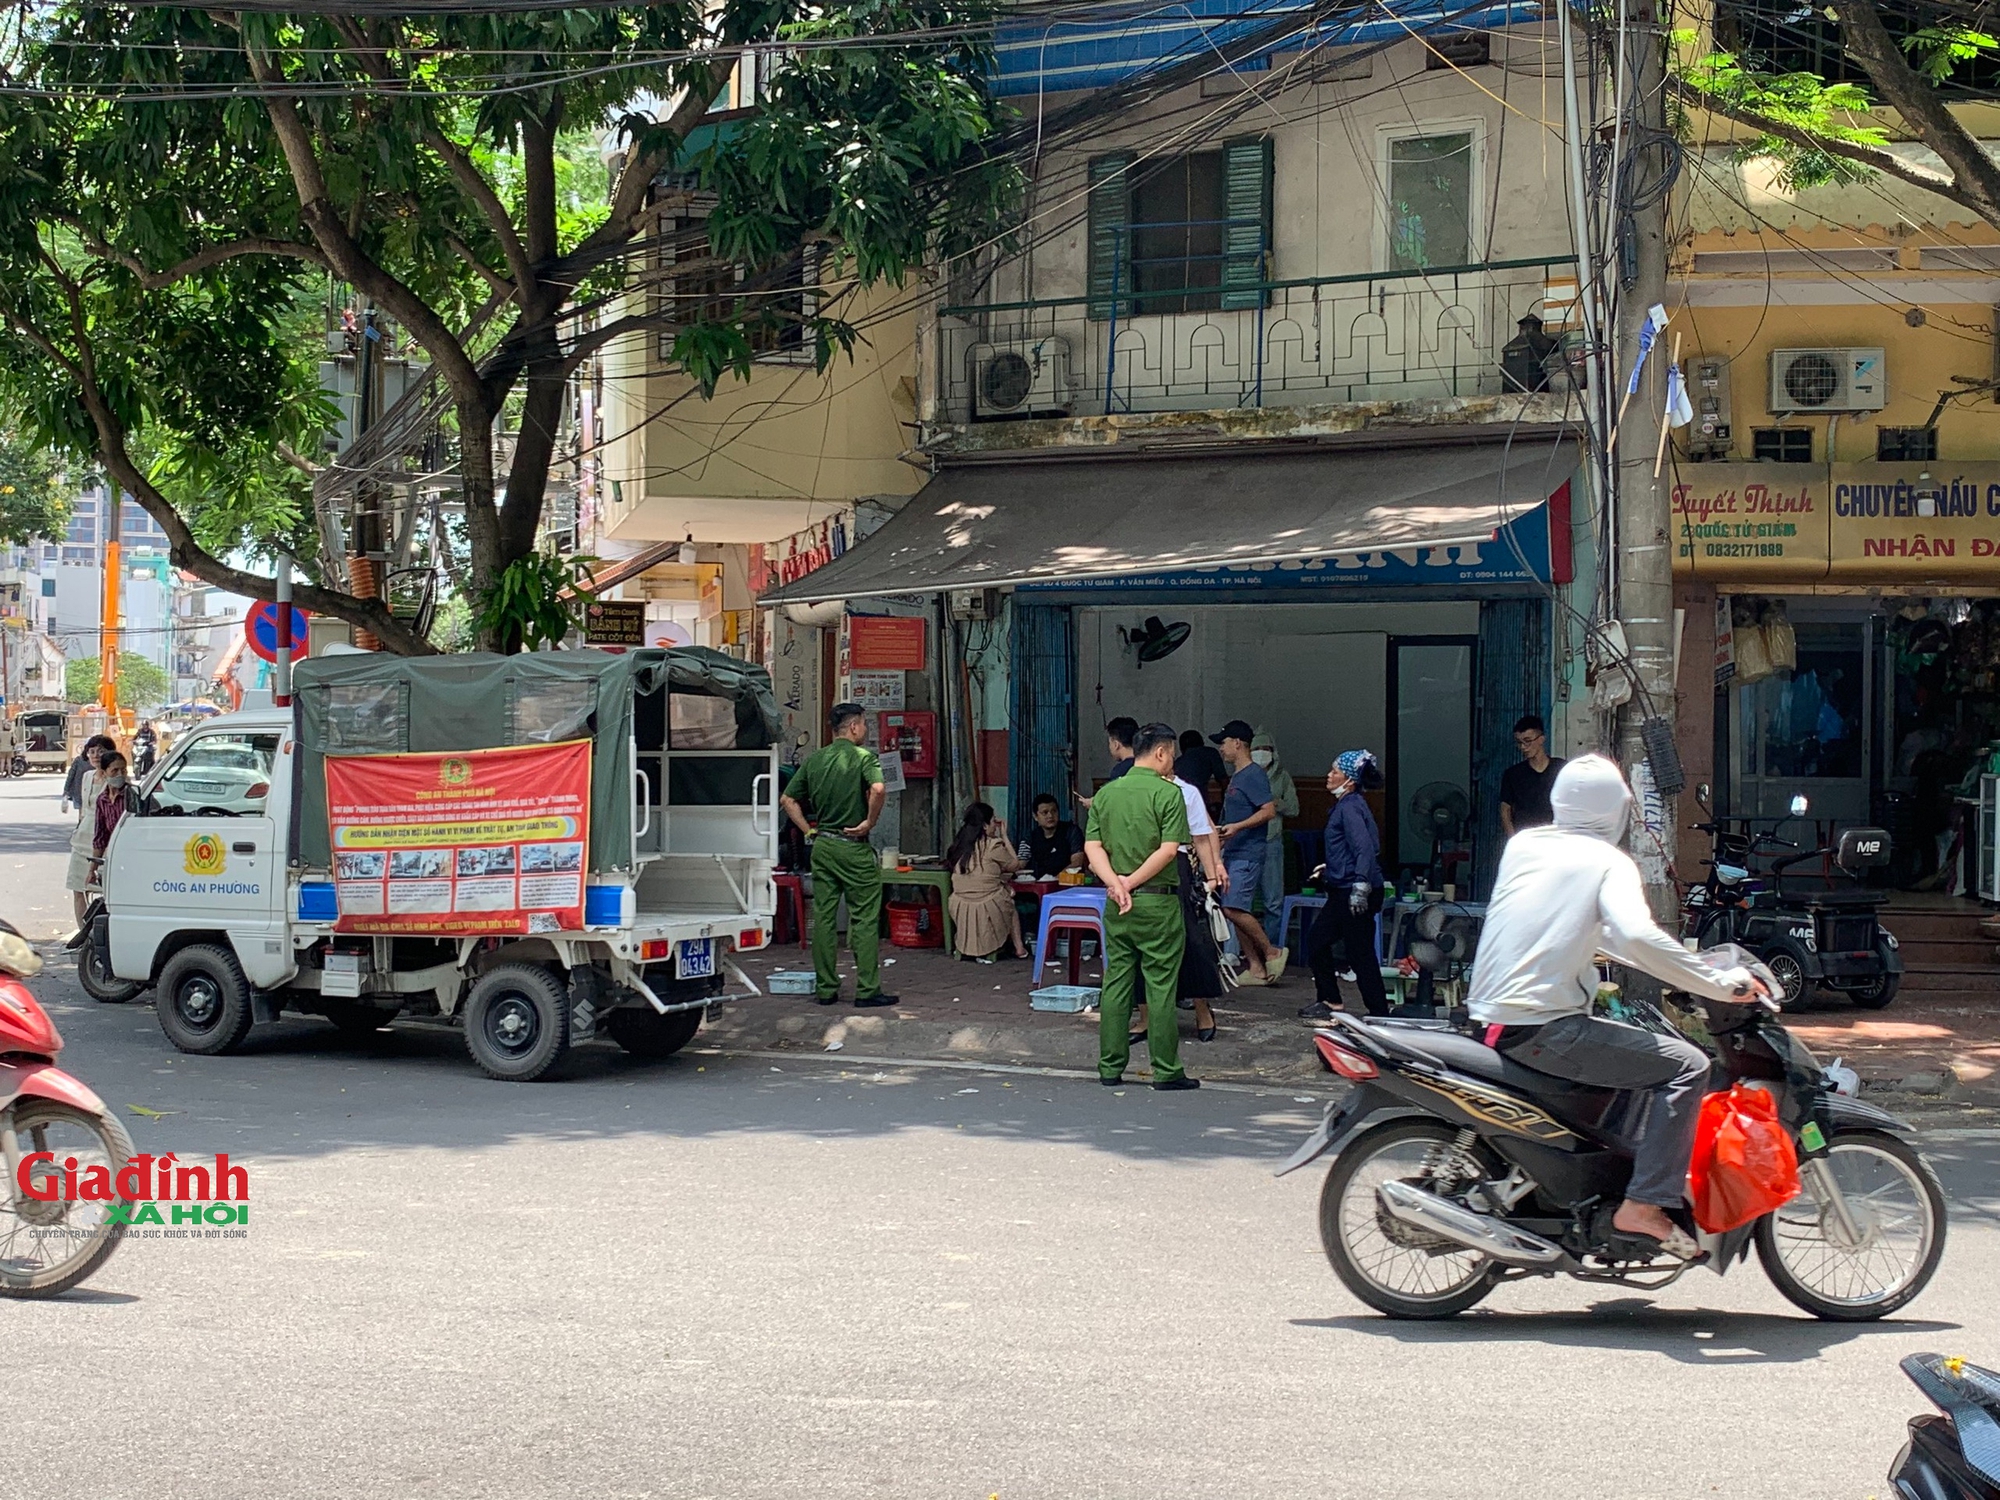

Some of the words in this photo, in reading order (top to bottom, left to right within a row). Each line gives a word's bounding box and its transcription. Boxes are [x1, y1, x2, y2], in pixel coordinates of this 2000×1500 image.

[1672, 484, 1737, 523] Tuyết
[1745, 484, 1814, 516] Thịnh
[1706, 543, 1783, 557] 0832171888
[1864, 534, 1955, 562] NHẬN
[153, 880, 186, 893] CÔNG
[190, 883, 206, 893] AN
[210, 880, 260, 894] PHƯỜNG
[687, 938, 704, 956] 29A
[681, 956, 711, 976] 043.42
